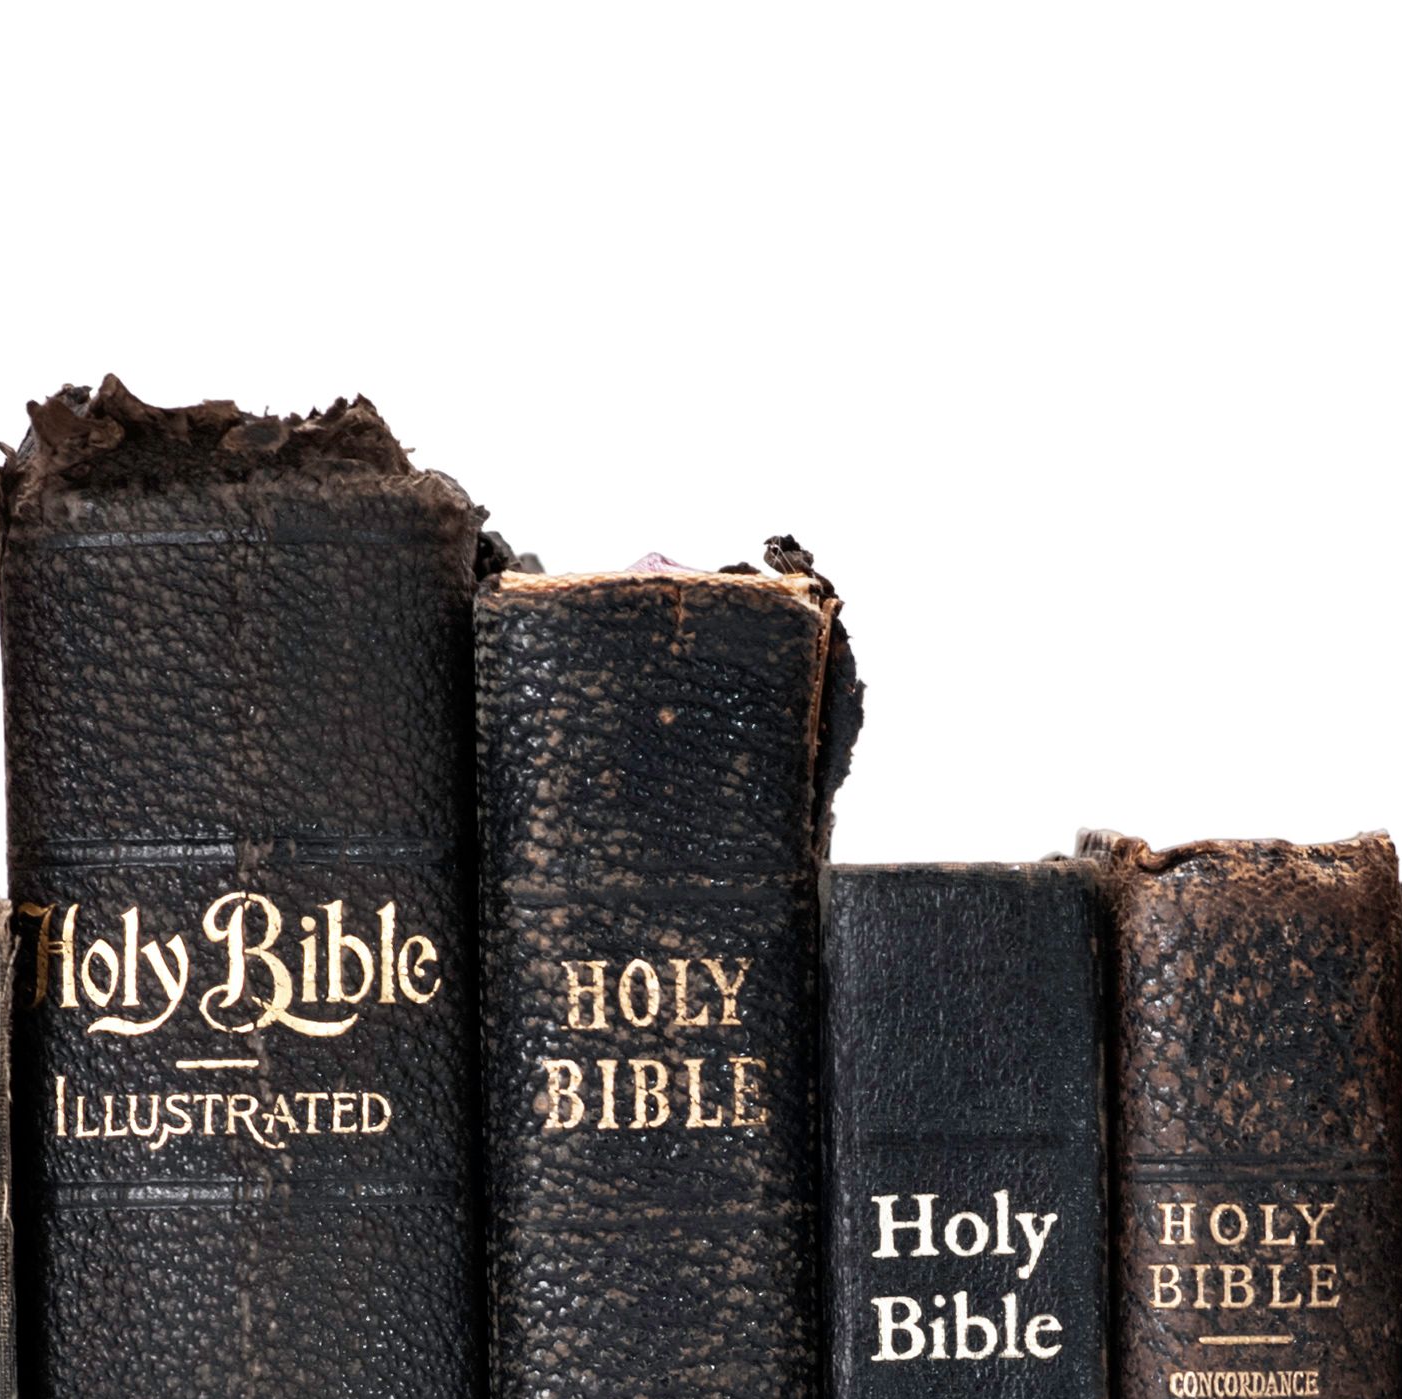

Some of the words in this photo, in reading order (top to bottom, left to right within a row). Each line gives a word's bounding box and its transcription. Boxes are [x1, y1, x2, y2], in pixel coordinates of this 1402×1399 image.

[16, 891, 189, 1036] Holy
[200, 891, 442, 1036] Bible
[561, 957, 752, 1030] HOLY
[542, 1056, 768, 1130] BIBLE
[871, 1189, 1058, 1278] Holy
[1157, 1202, 1336, 1246] HOLY
[1148, 1264, 1341, 1309] BIBLE
[871, 1292, 1063, 1361] Bible
[1169, 1371, 1320, 1399] CONCORDANCE
